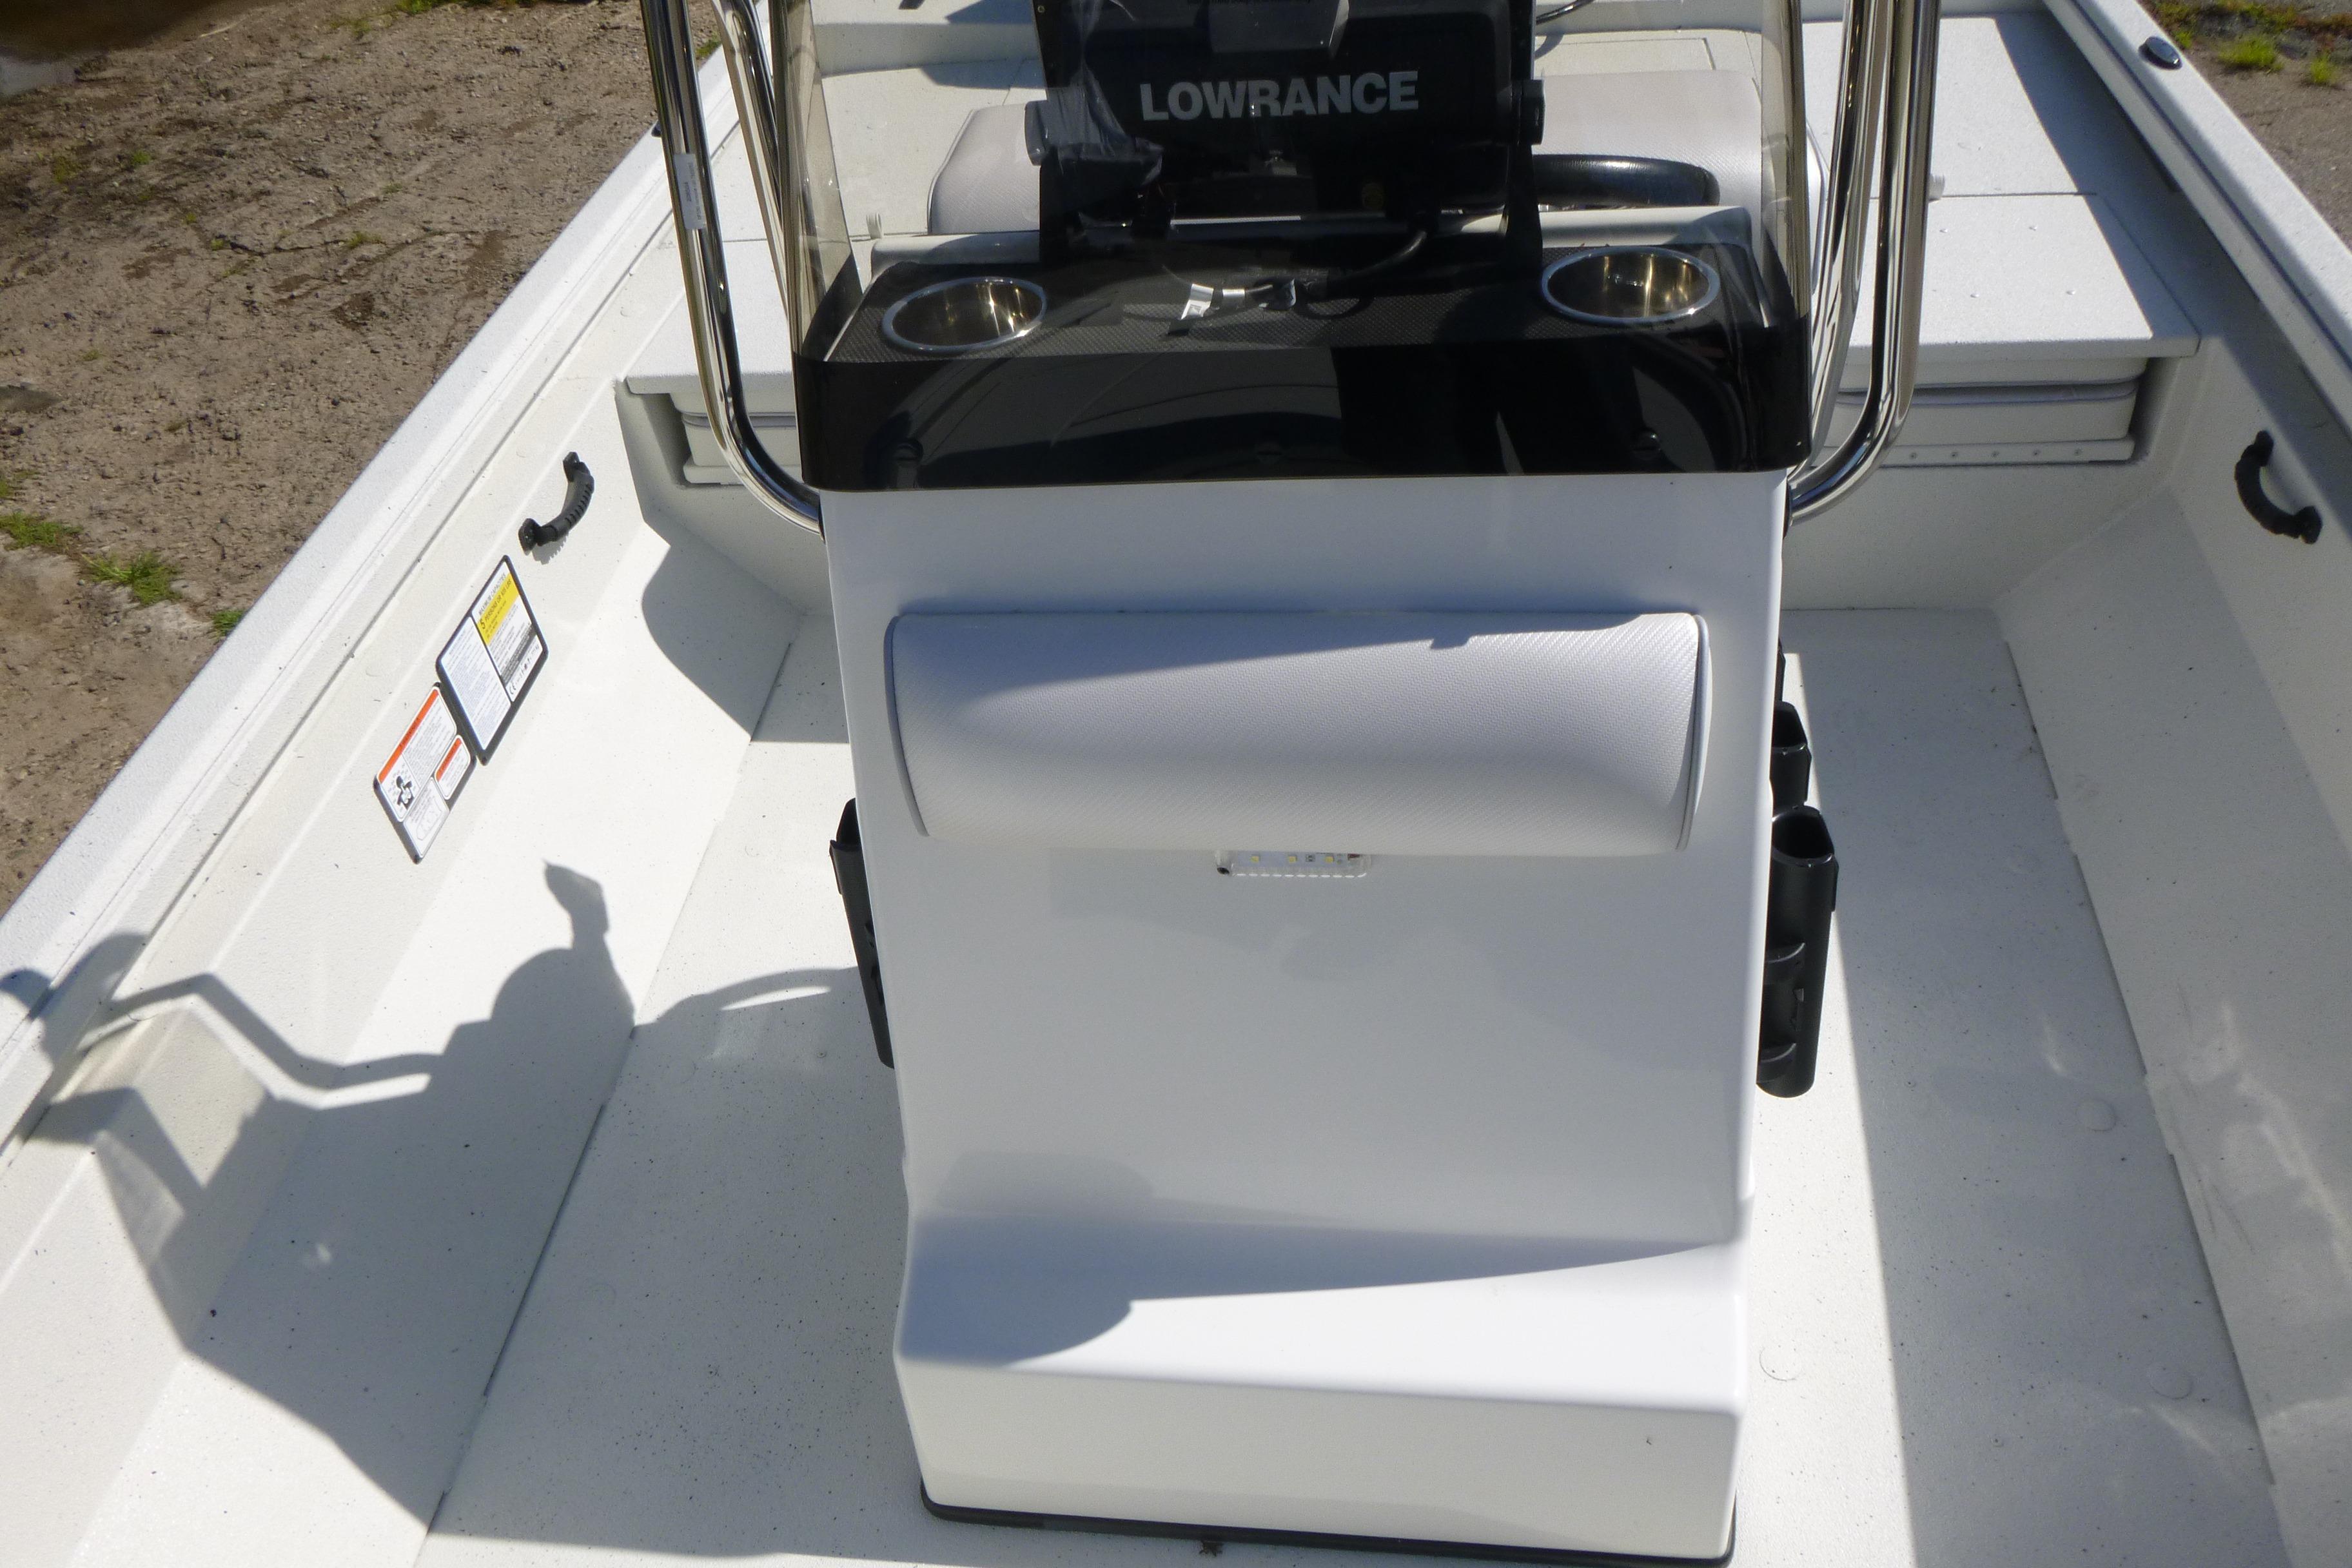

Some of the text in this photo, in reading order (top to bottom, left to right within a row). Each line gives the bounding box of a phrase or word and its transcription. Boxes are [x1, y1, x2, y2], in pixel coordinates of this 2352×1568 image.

[1140, 71, 1418, 121] LOWRANCE
[480, 618, 486, 630] 5
[485, 602, 498, 623] PERSONS
[496, 593, 502, 604] OR
